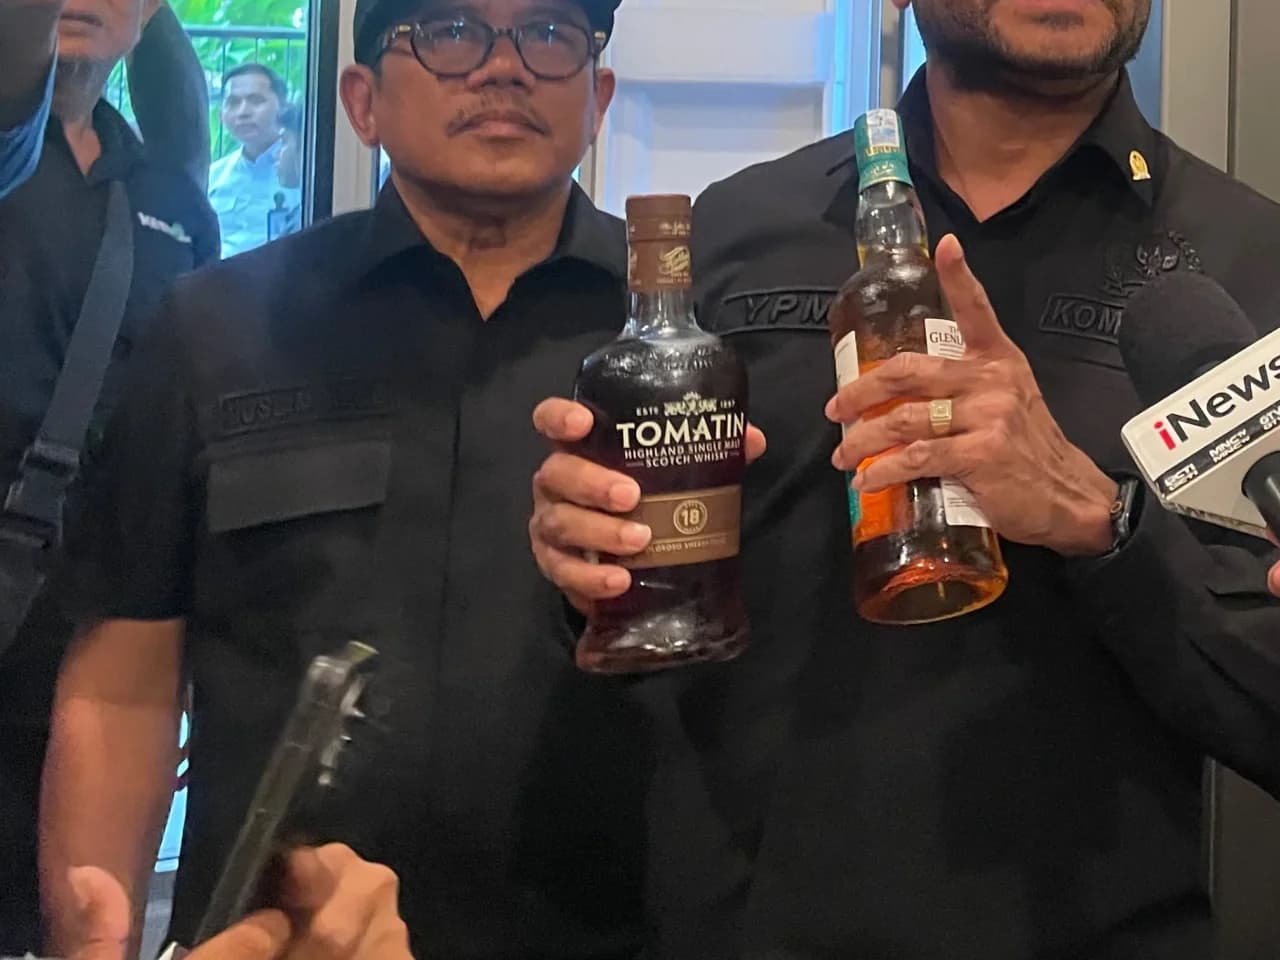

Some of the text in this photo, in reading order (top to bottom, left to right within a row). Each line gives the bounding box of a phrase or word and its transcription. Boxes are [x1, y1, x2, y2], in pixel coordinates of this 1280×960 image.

[1052, 299, 1122, 336] KOM
[616, 412, 744, 449] TOMATIN
[624, 445, 685, 460] HIGHLAND
[687, 439, 722, 454] SINGLE
[645, 450, 729, 468] SCOTCH WHISKY
[681, 508, 700, 526] 18
